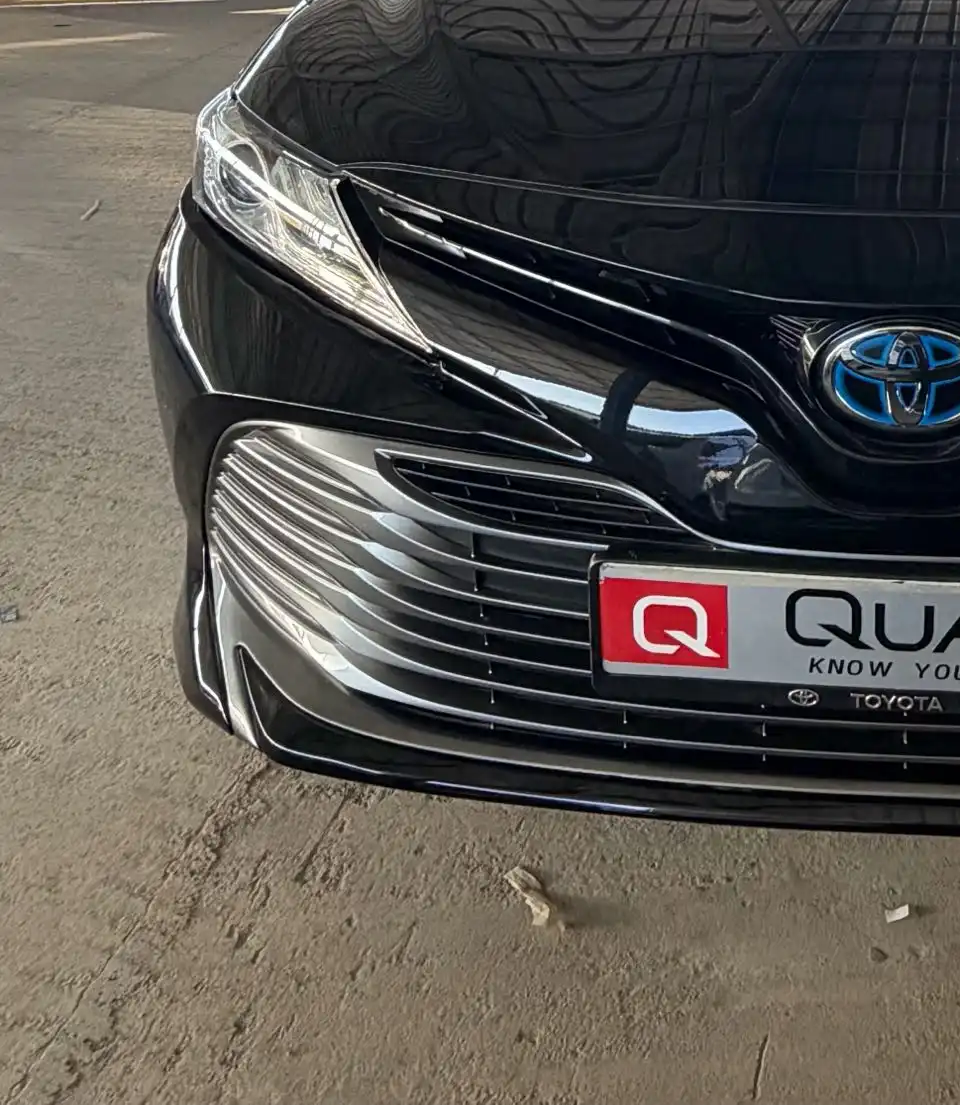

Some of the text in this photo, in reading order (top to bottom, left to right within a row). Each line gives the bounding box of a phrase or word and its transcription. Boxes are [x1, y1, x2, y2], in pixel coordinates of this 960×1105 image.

[632, 595, 721, 658] Q
[808, 657, 893, 678] KNOW
[850, 693, 944, 712] TOYOTA
